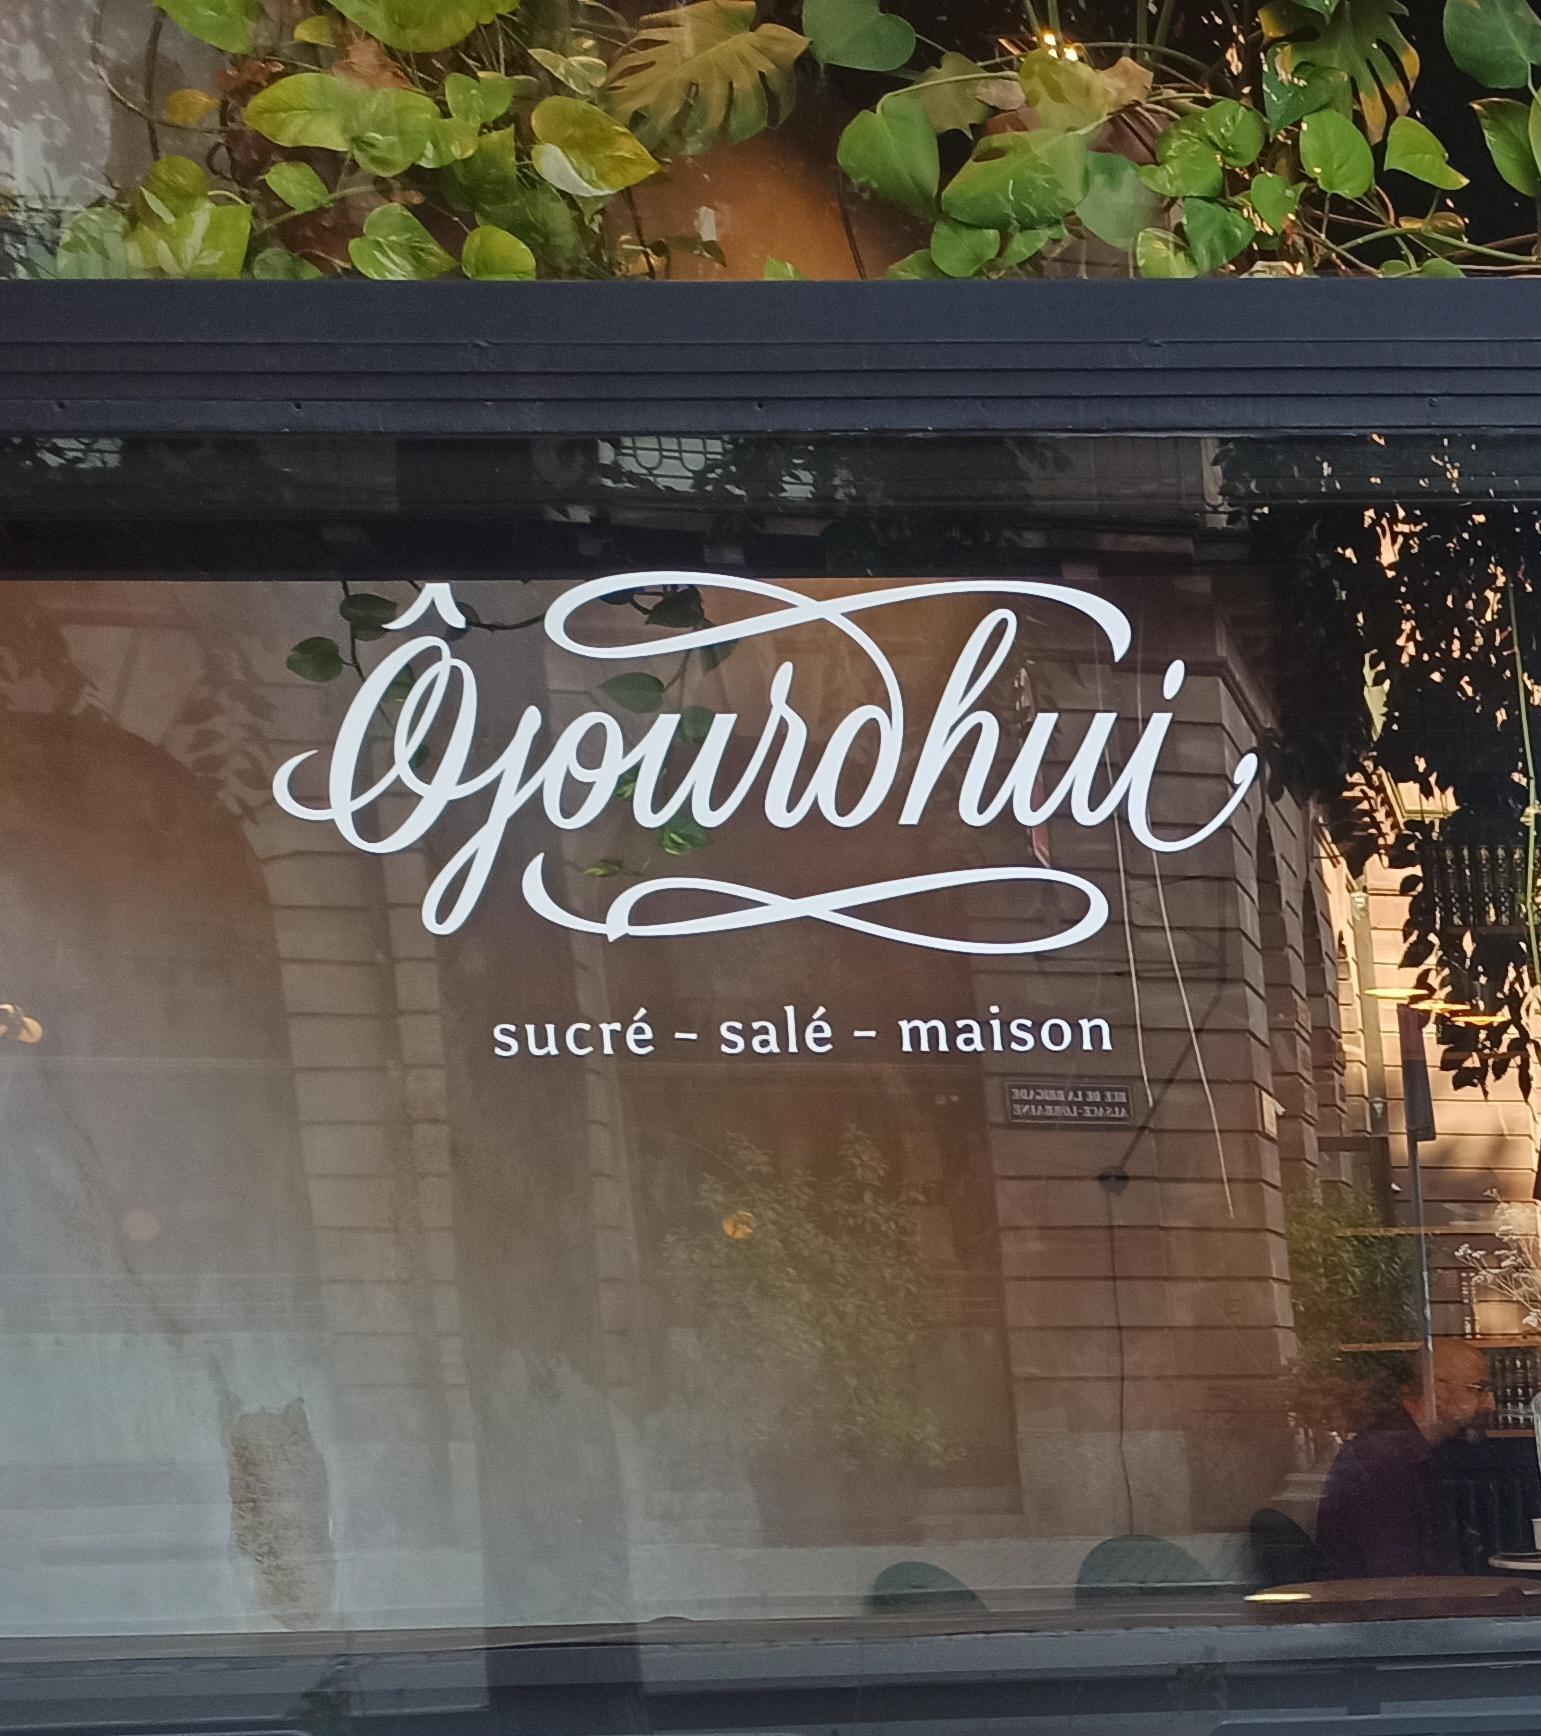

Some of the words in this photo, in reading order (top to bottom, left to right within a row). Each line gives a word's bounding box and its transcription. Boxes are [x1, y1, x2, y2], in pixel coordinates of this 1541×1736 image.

[493, 1006, 655, 1057] sucré
[719, 1005, 833, 1053] salé
[898, 1005, 1113, 1052] maison
